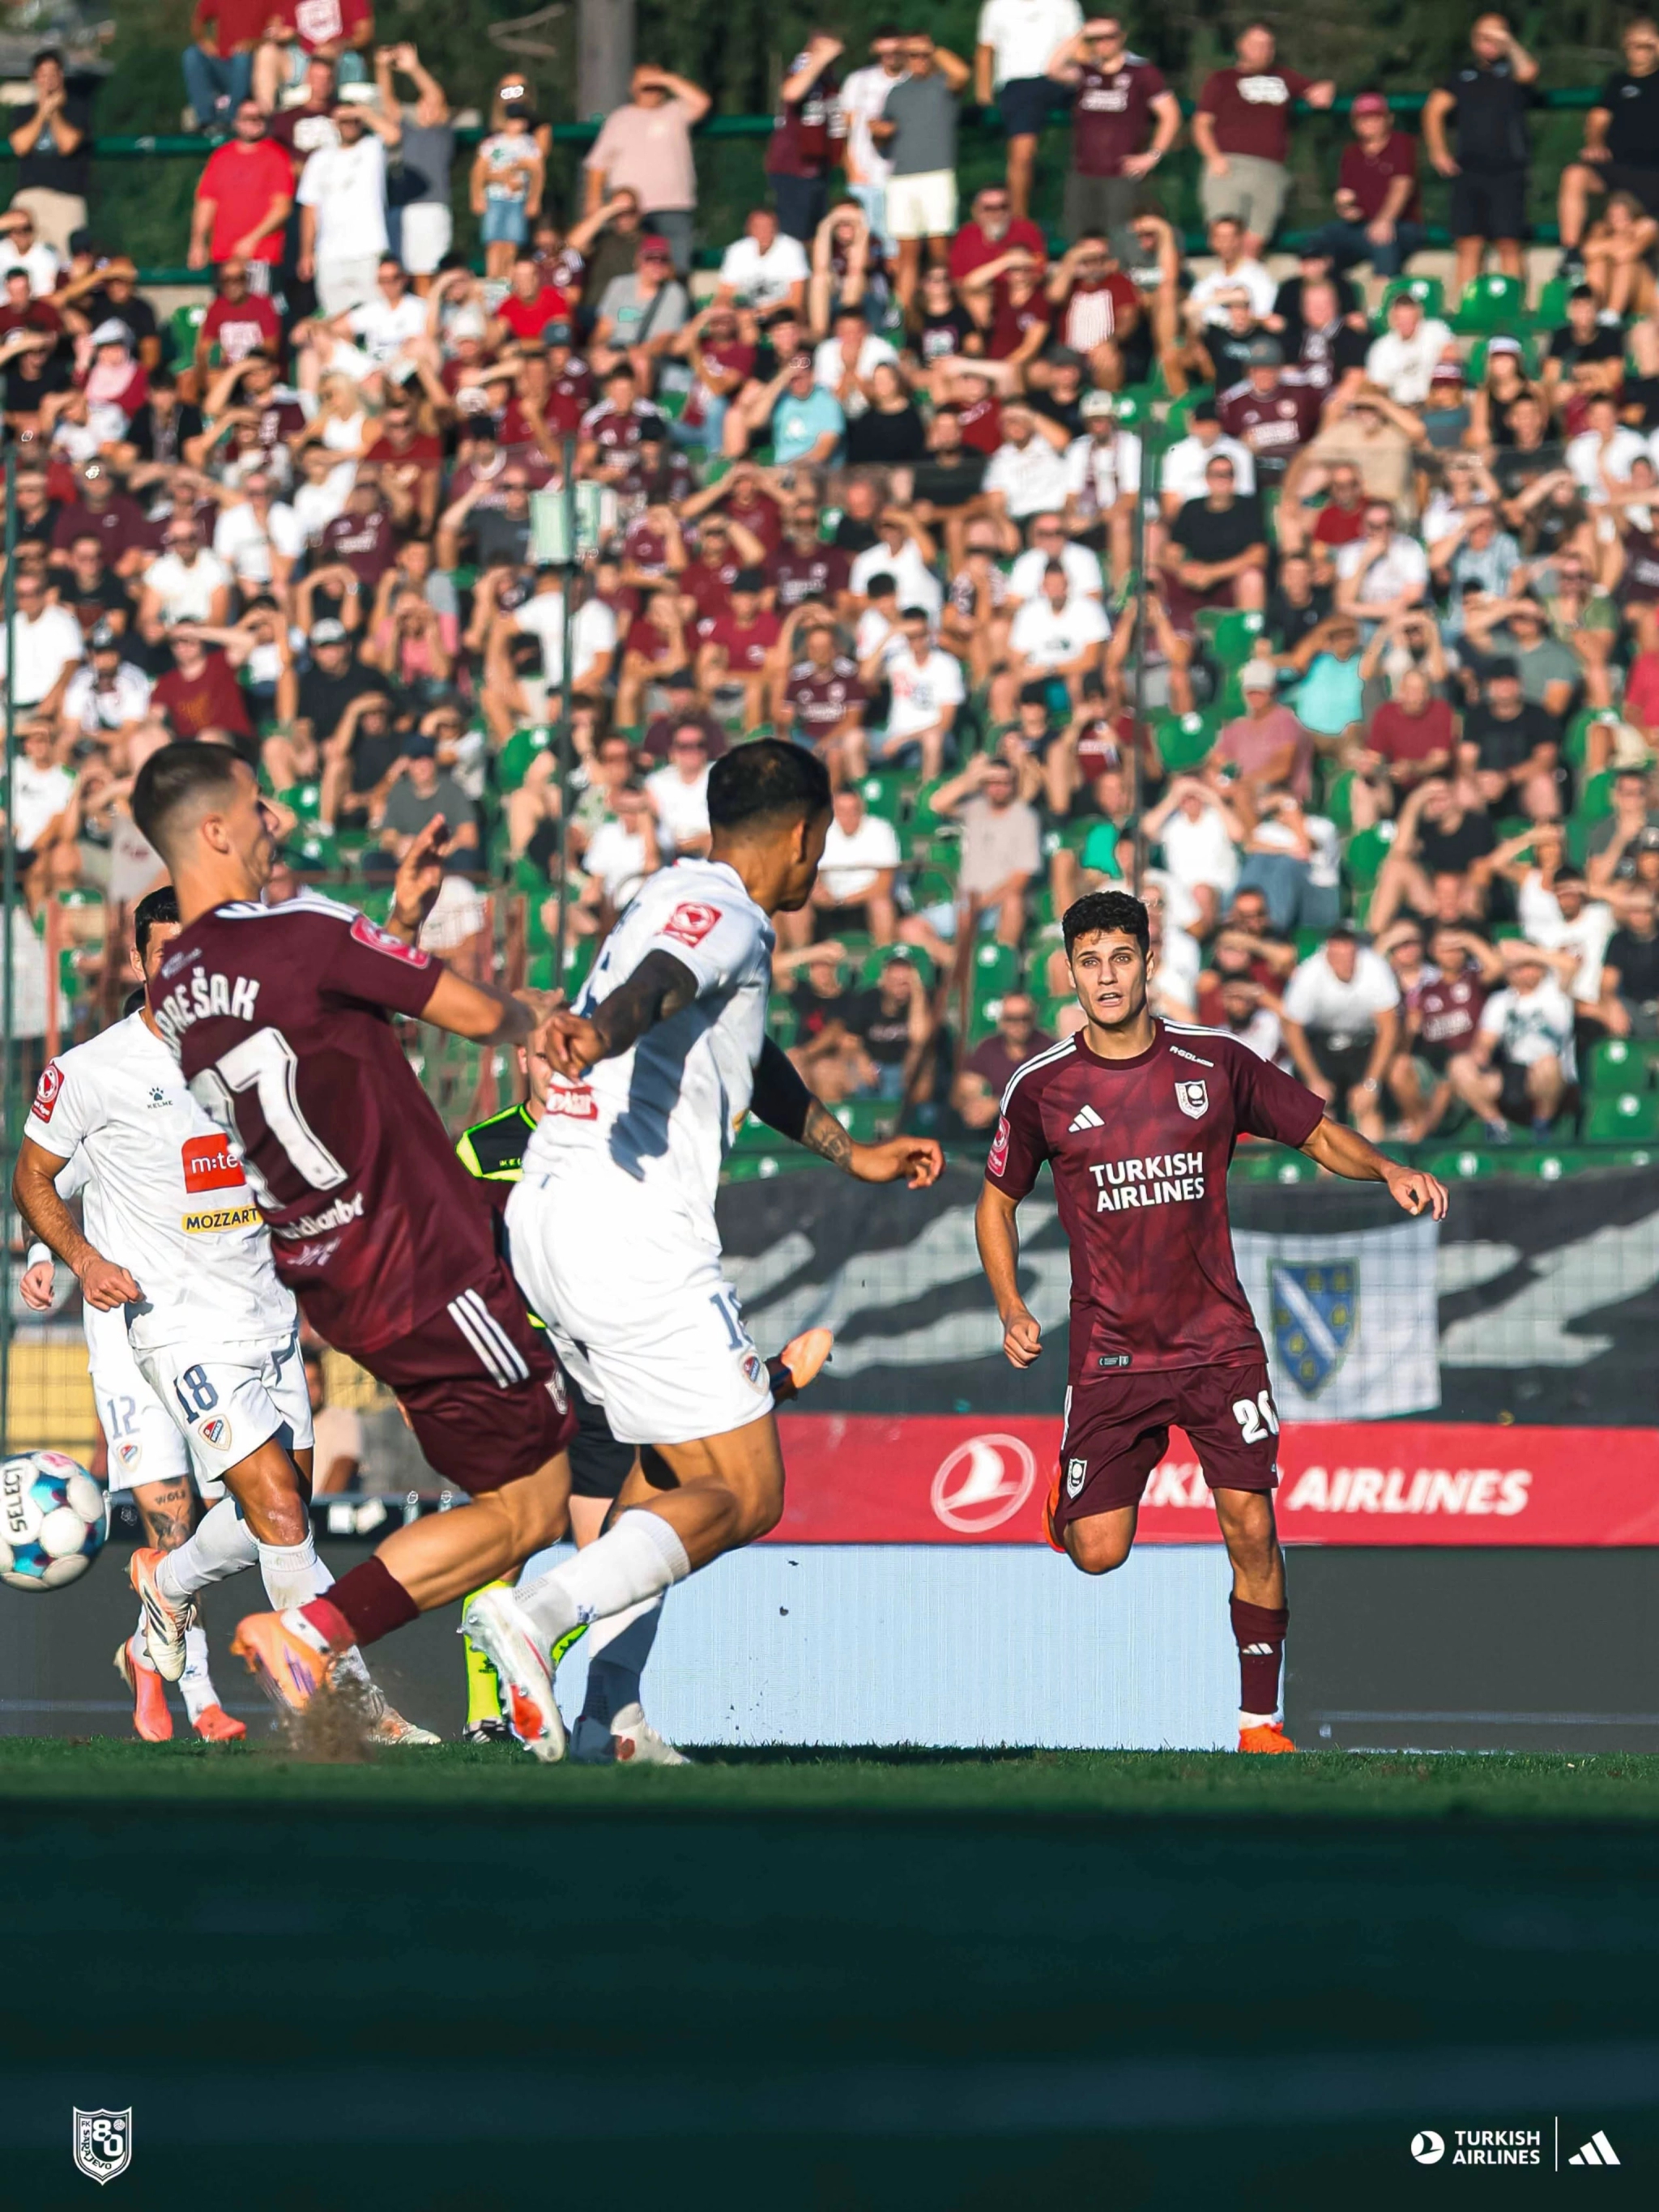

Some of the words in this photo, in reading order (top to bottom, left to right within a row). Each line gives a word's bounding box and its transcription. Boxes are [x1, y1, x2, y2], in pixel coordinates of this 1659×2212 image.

[147, 1100, 173, 1110] KELME
[191, 1151, 243, 1174] m:te
[1089, 1151, 1204, 1187] TURKISH
[1096, 1177, 1205, 1213] AIRLINES
[186, 1207, 258, 1230] MOZZART
[173, 1364, 219, 1426] 18
[107, 1395, 141, 1440] 12
[3, 1466, 28, 1532] SELECT
[1285, 1465, 1533, 1516] AIRLINES
